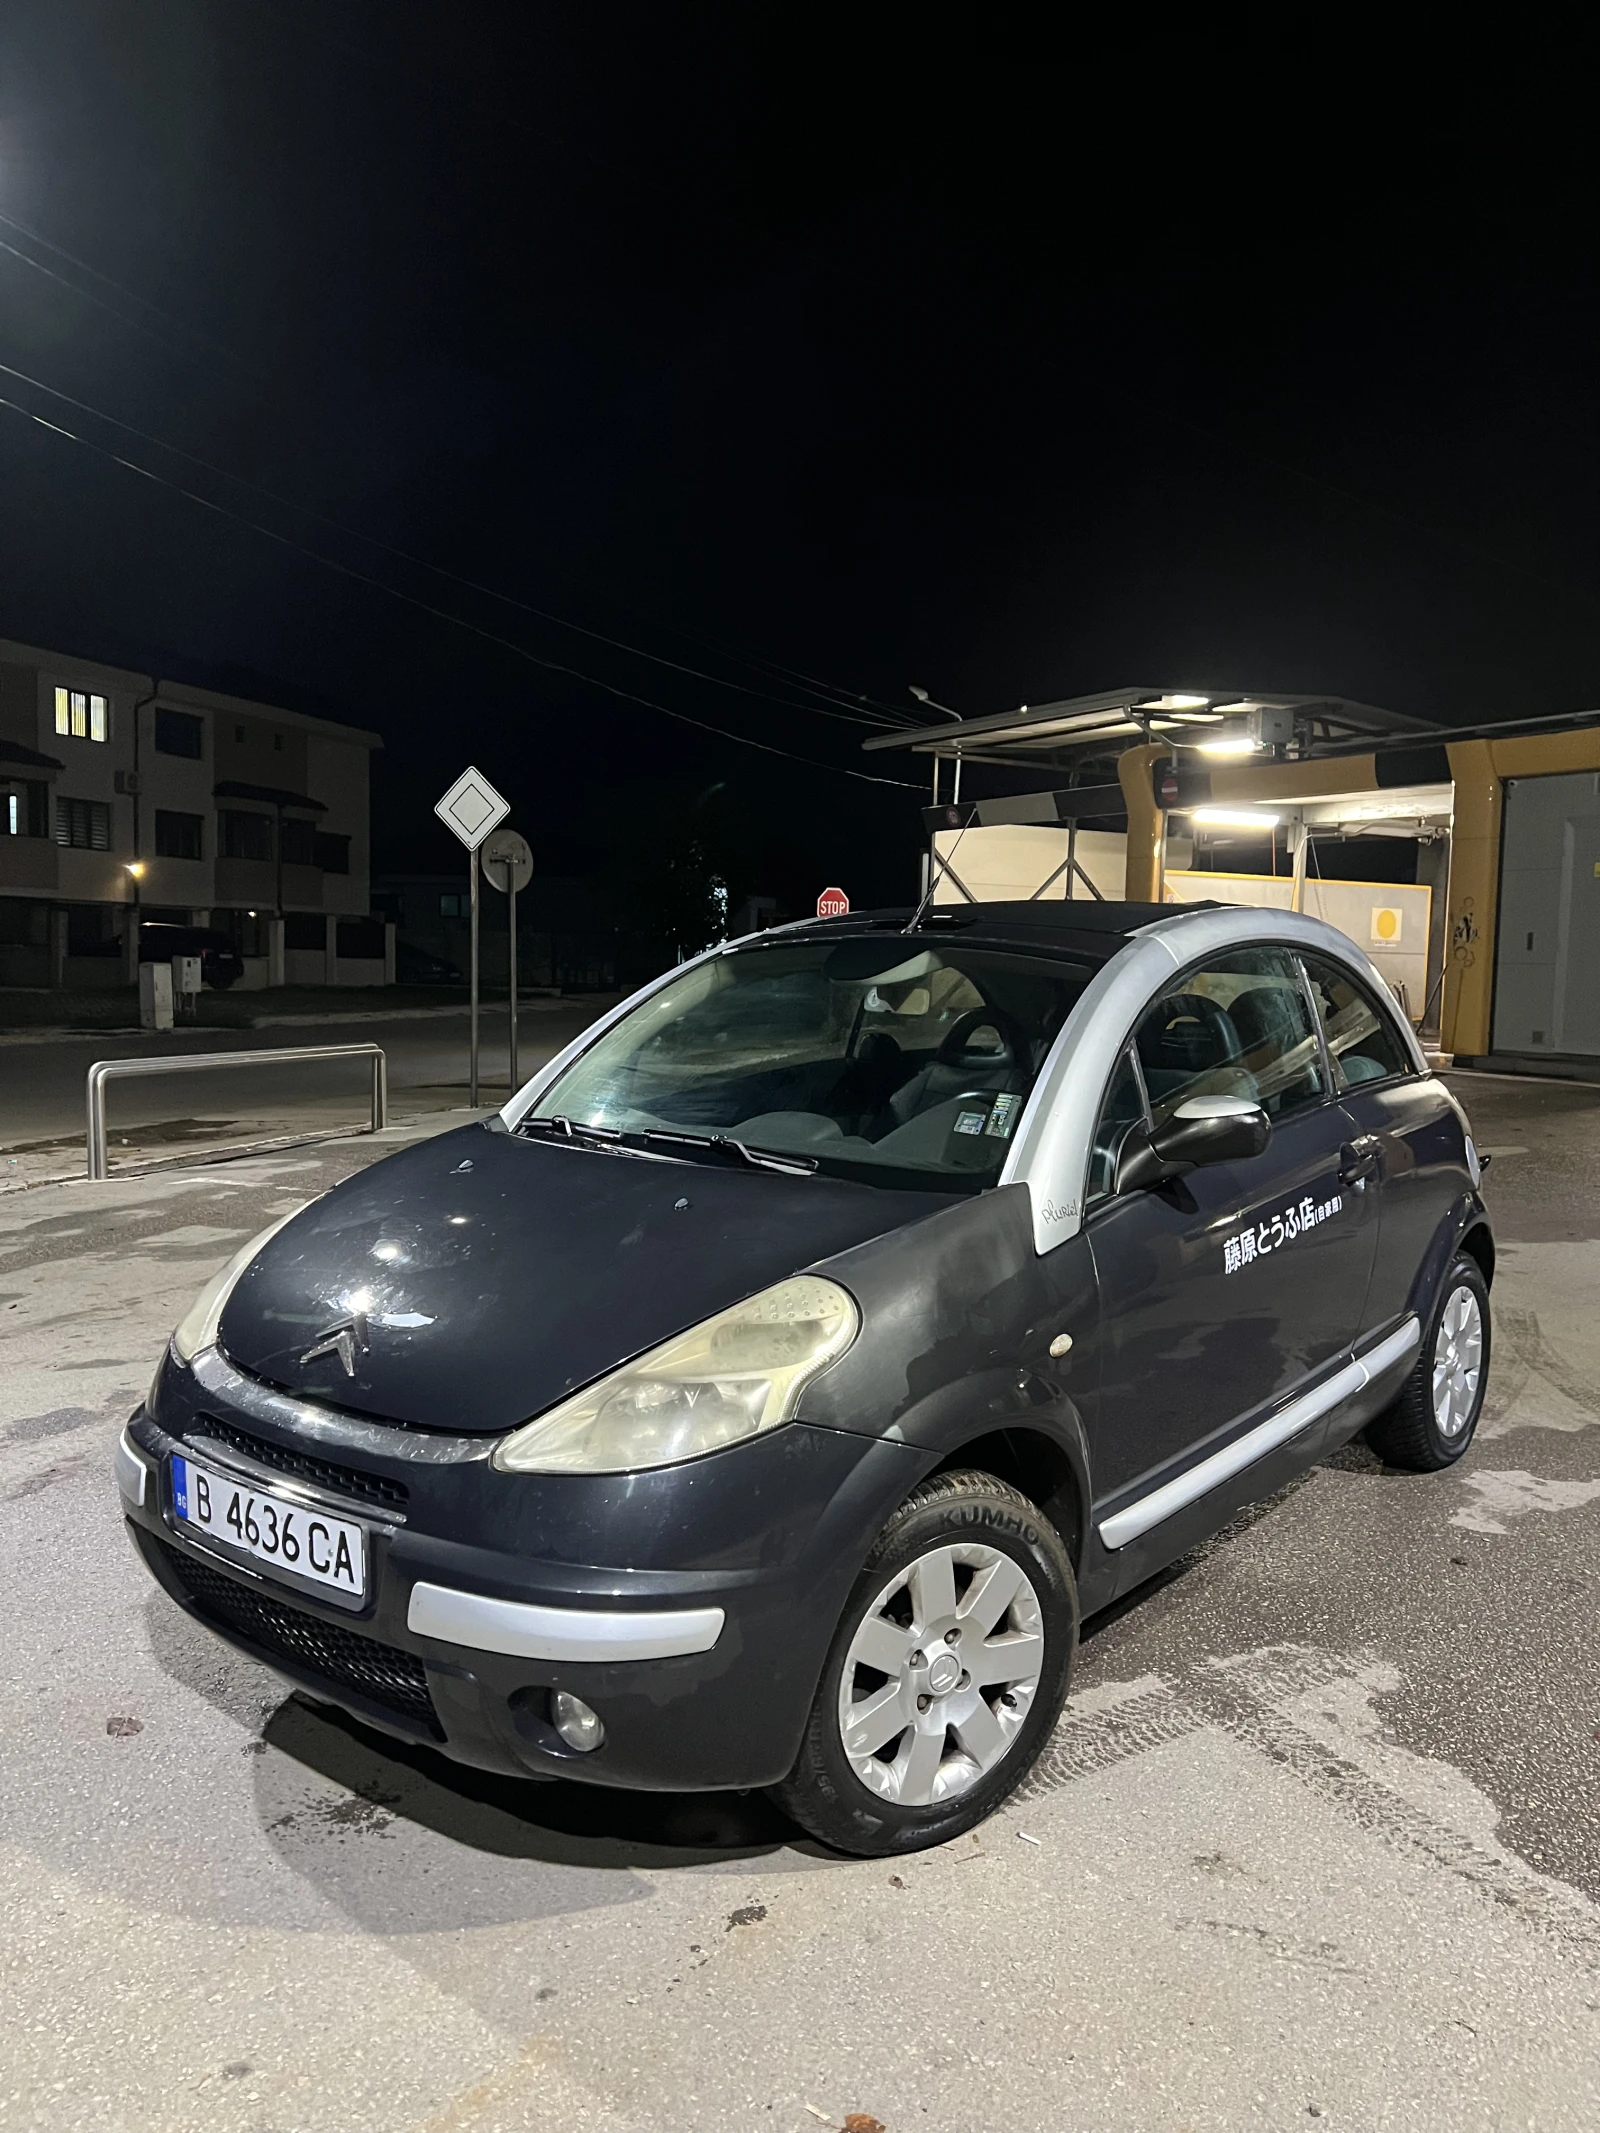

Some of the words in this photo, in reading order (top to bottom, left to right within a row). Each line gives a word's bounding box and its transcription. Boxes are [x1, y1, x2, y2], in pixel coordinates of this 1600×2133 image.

[820, 900, 846, 915] STOP
[176, 1492, 188, 1510] BG
[196, 1473, 212, 1524] B
[226, 1491, 301, 1563] 4636
[308, 1521, 355, 1584] CA
[940, 1504, 1040, 1546] KUMHO
